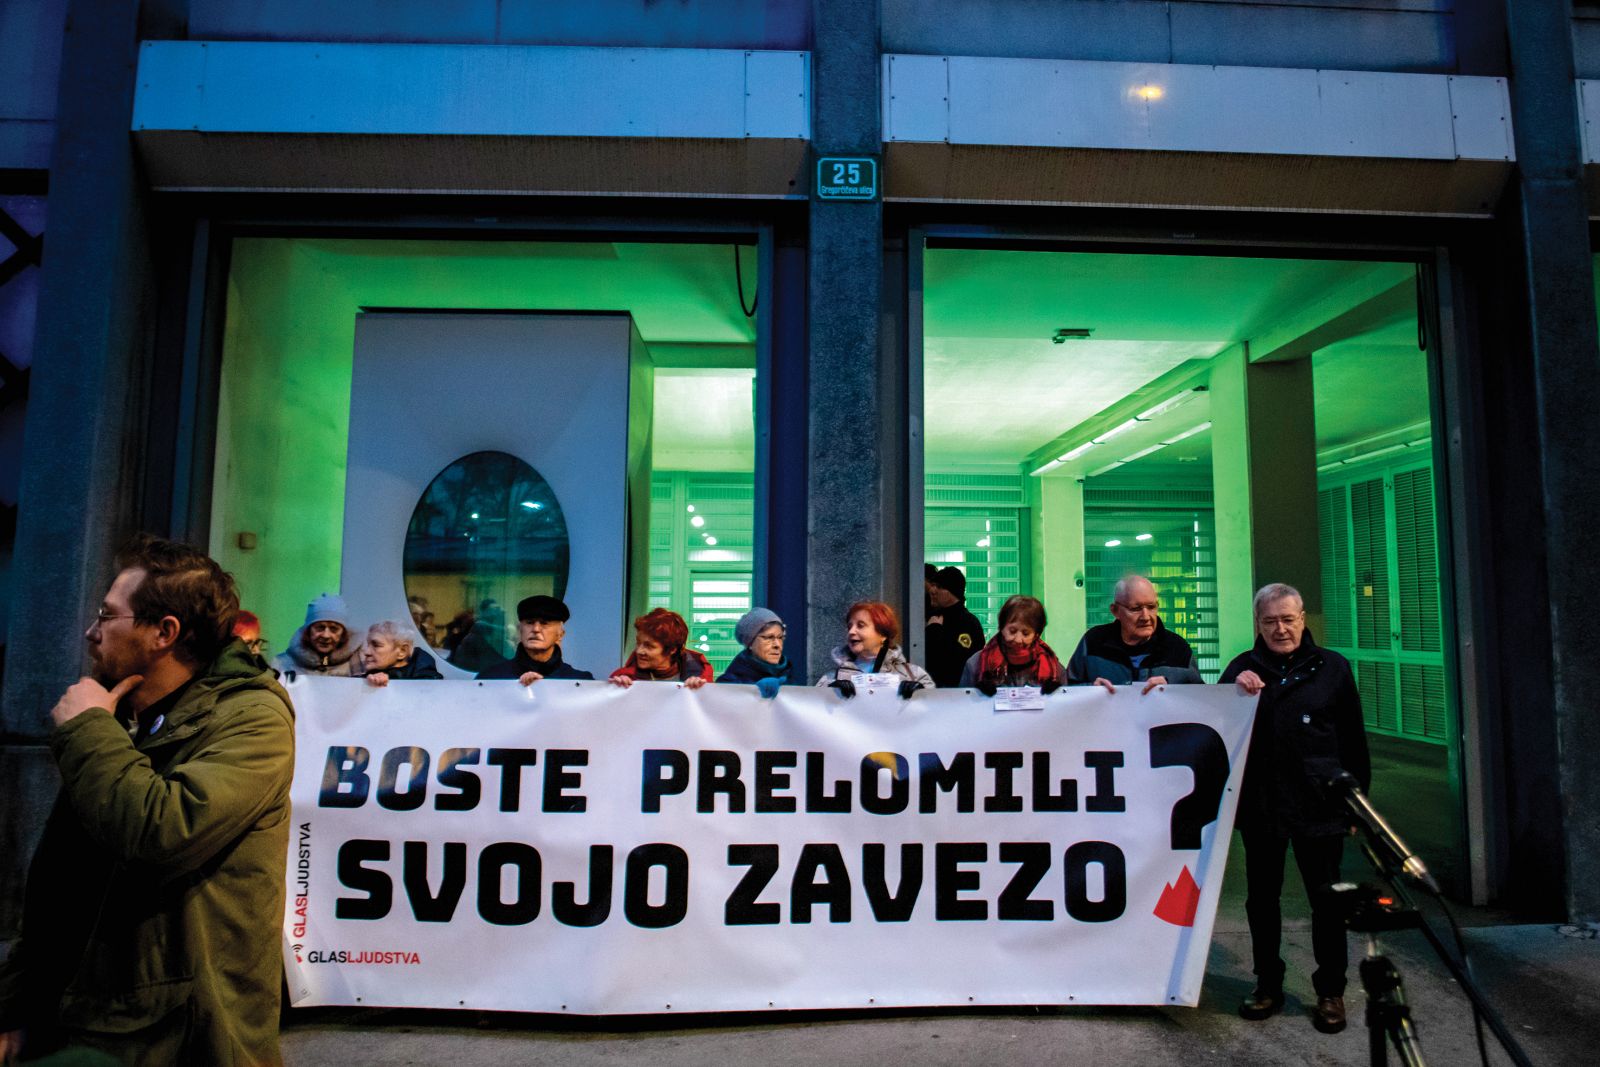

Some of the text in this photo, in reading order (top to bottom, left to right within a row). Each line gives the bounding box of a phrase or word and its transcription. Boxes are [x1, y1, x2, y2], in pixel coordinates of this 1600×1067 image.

[832, 163, 860, 185] 25
[318, 746, 1127, 816] BOSTE PRELOMILI
[293, 822, 311, 938] GLASLJUDSTVA
[335, 839, 1127, 929] SVOJO ZAVEZO
[308, 951, 420, 964] GLASLJUDSTVA
